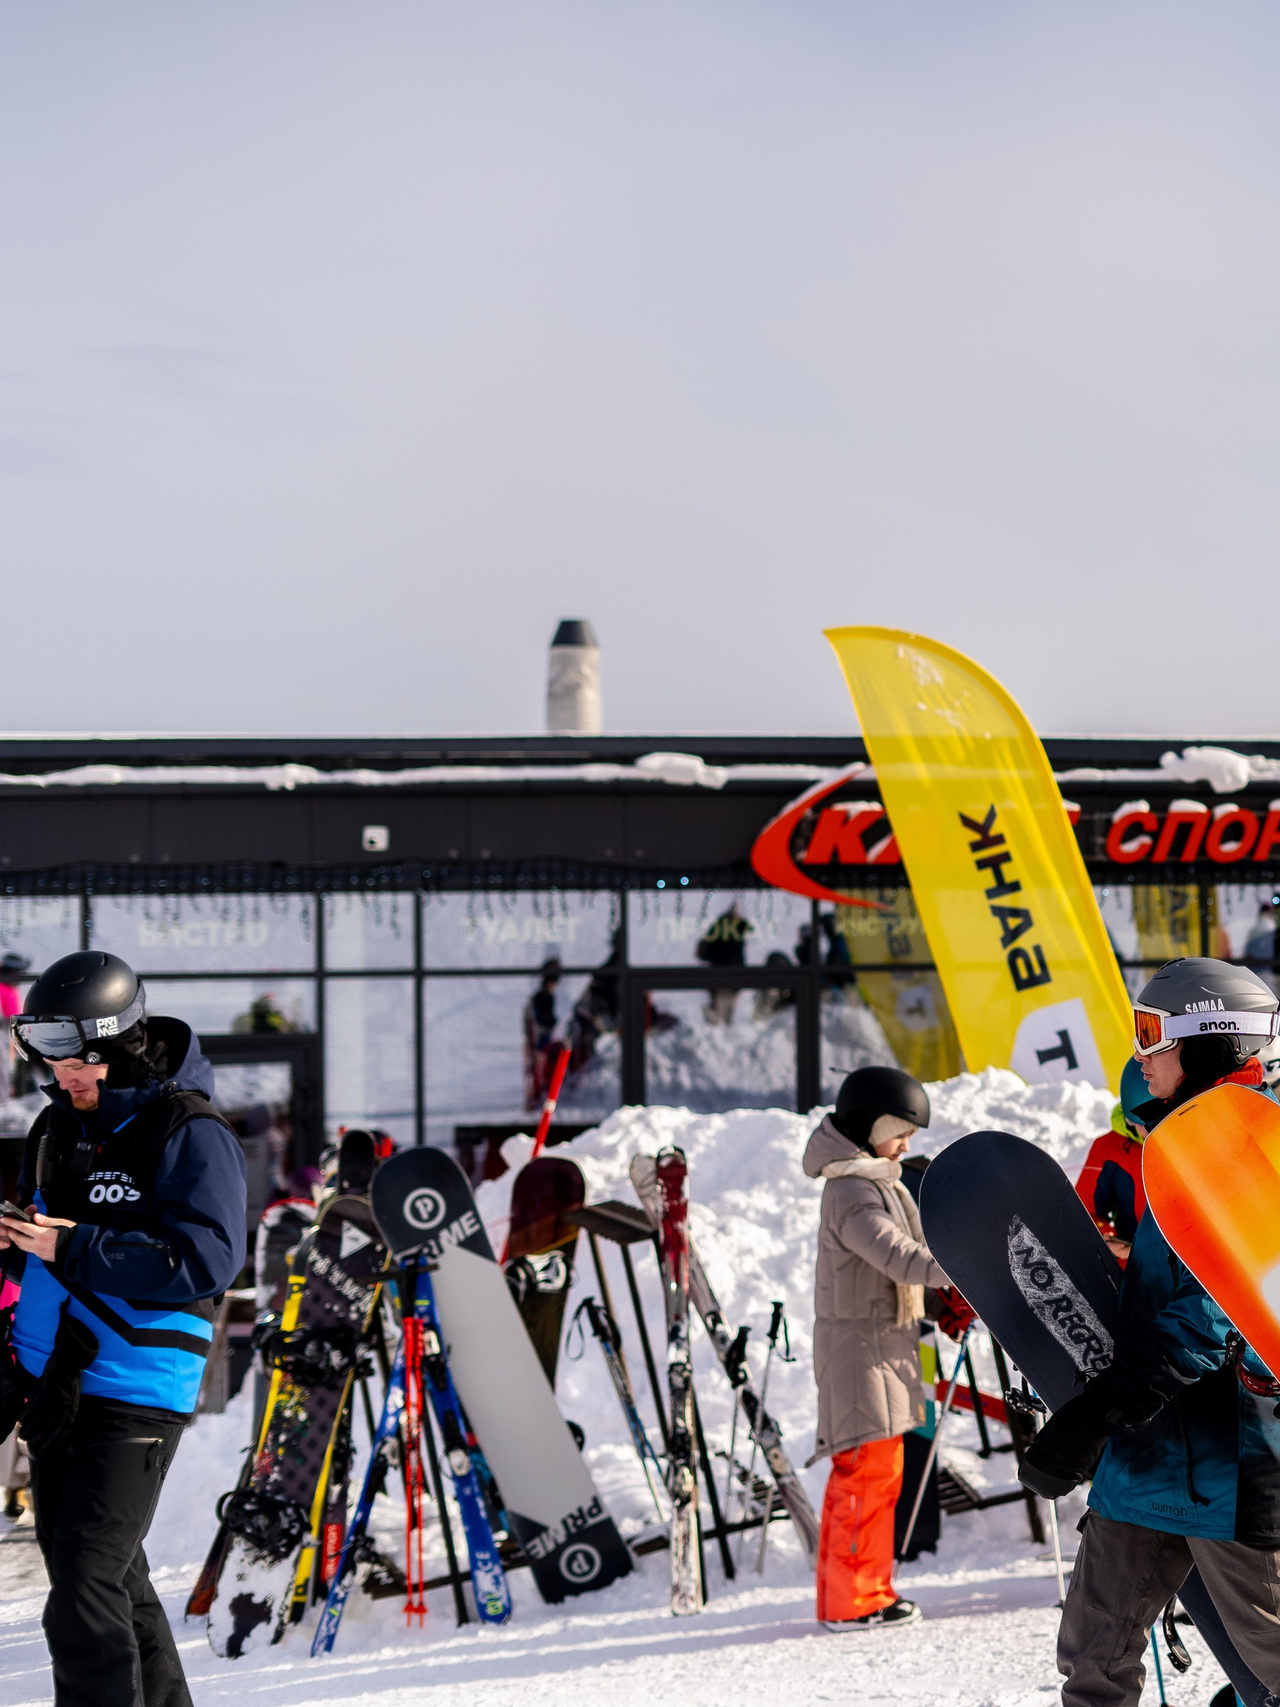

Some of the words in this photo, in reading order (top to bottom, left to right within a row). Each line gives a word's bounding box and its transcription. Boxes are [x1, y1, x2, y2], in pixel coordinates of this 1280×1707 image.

[1199, 1020, 1240, 1032] anon.
[1014, 1247, 1054, 1291] NO
[1043, 1293, 1111, 1371] REGRE
[526, 1496, 607, 1559] PRIME
